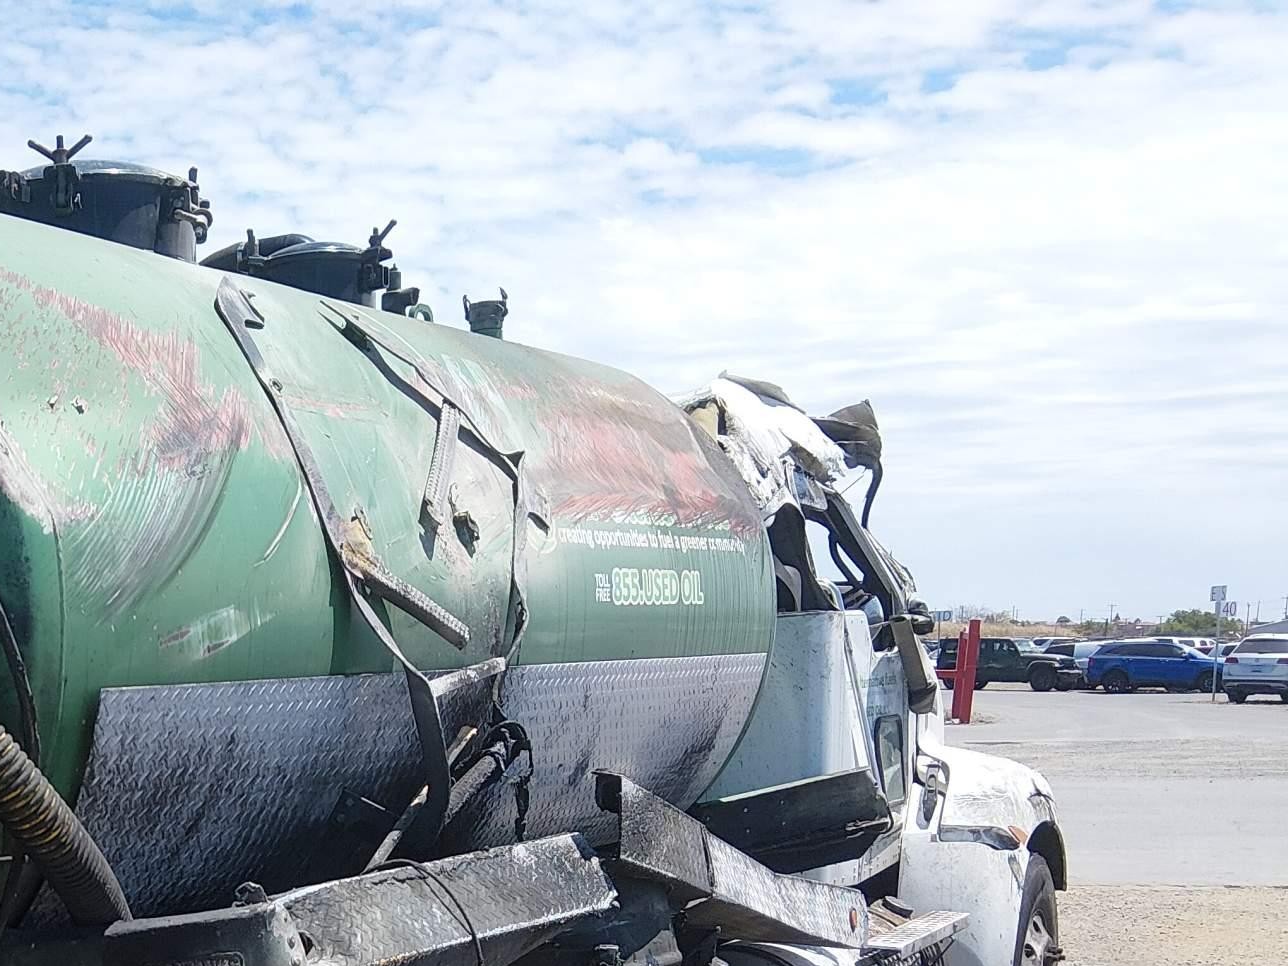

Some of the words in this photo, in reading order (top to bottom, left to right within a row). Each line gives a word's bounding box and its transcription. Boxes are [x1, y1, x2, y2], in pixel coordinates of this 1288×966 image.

[558, 523, 595, 549] creating
[594, 528, 649, 550] opportunities
[648, 531, 658, 548] to
[658, 530, 674, 549] fuel
[680, 535, 708, 554] greener
[595, 573, 611, 587] TOLL
[612, 567, 680, 606] 855.USED
[680, 569, 705, 605] OIL
[595, 587, 611, 602] FREE
